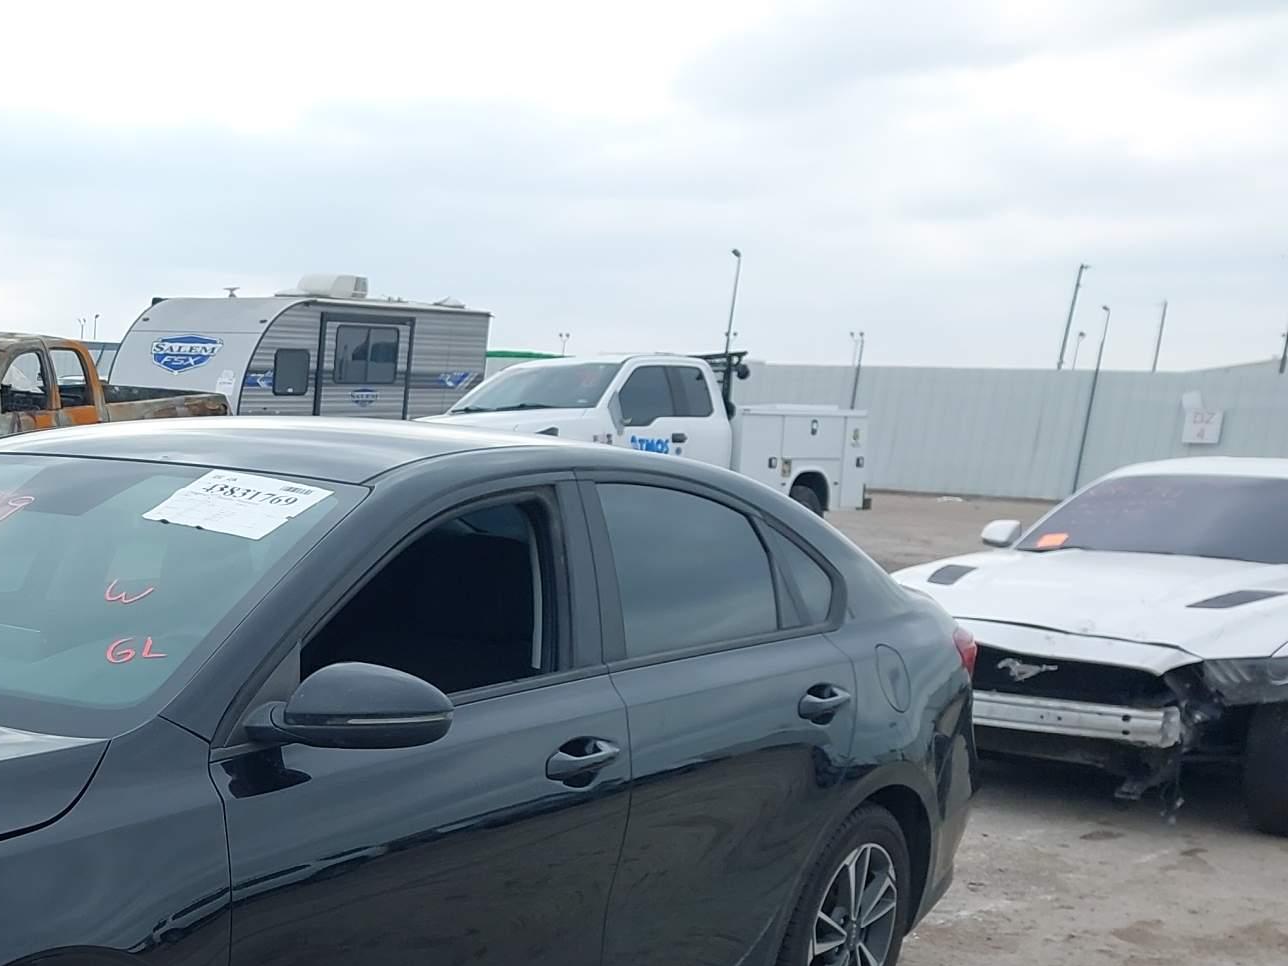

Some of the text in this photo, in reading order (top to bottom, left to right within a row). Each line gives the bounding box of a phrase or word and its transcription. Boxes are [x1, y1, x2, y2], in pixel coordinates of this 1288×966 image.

[153, 343, 217, 354] SALEM
[161, 356, 202, 365] FSX
[201, 483, 299, 507] 43831769
